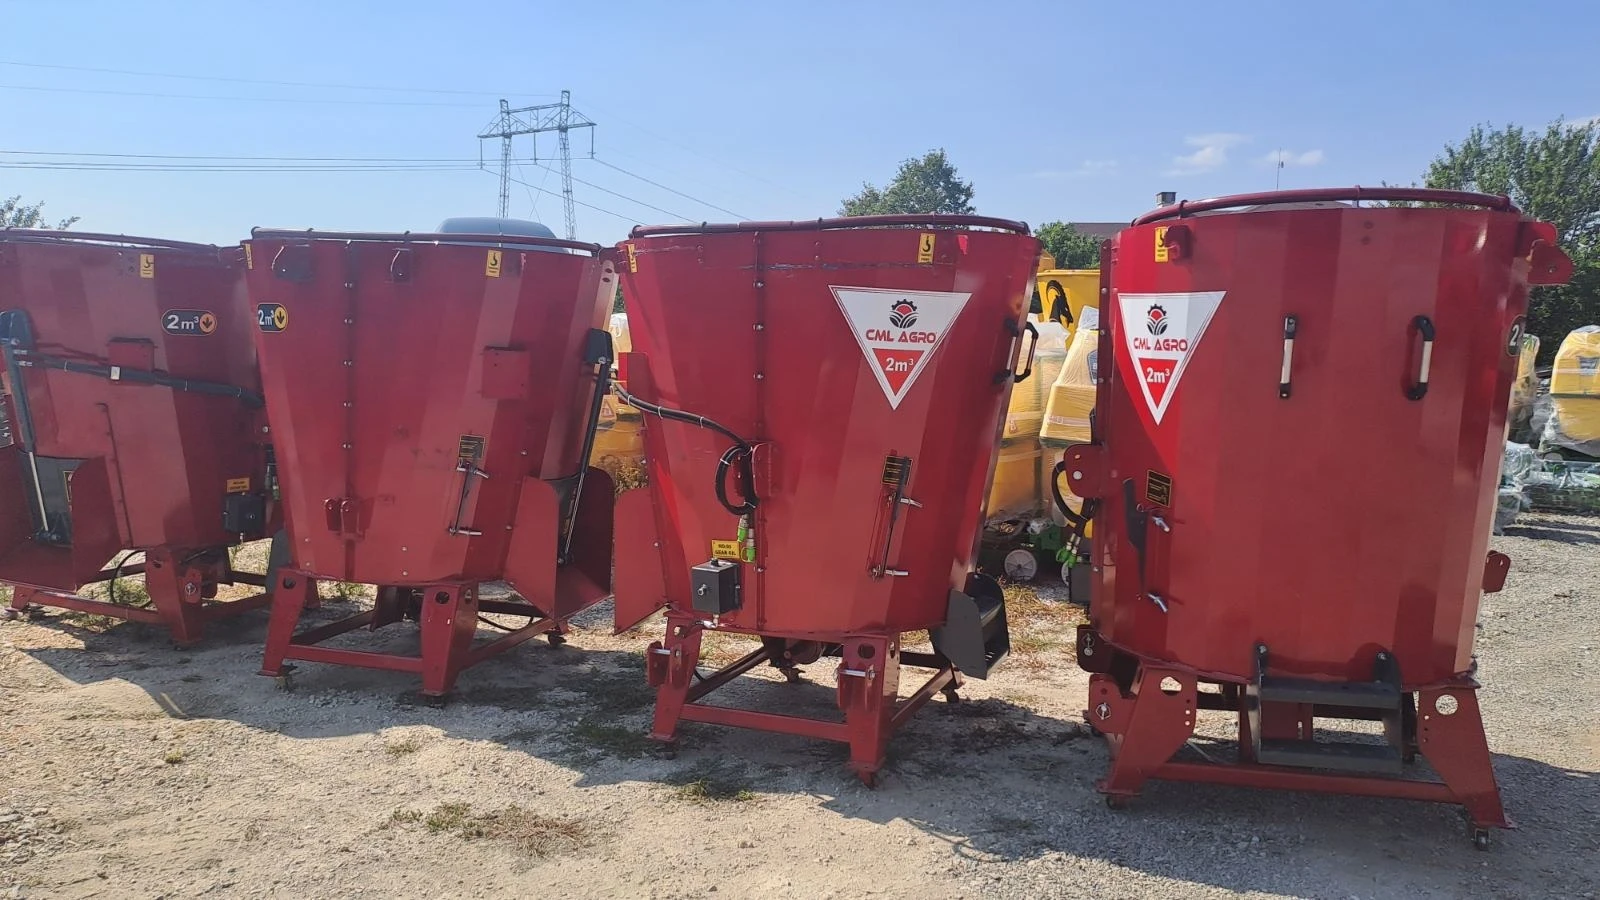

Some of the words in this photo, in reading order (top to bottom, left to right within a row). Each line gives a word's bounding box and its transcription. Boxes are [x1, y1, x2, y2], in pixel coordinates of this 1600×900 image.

[865, 328, 895, 342] CML
[898, 330, 937, 344] AGRO
[1133, 337, 1152, 350] CML
[1154, 338, 1189, 352] AGRO
